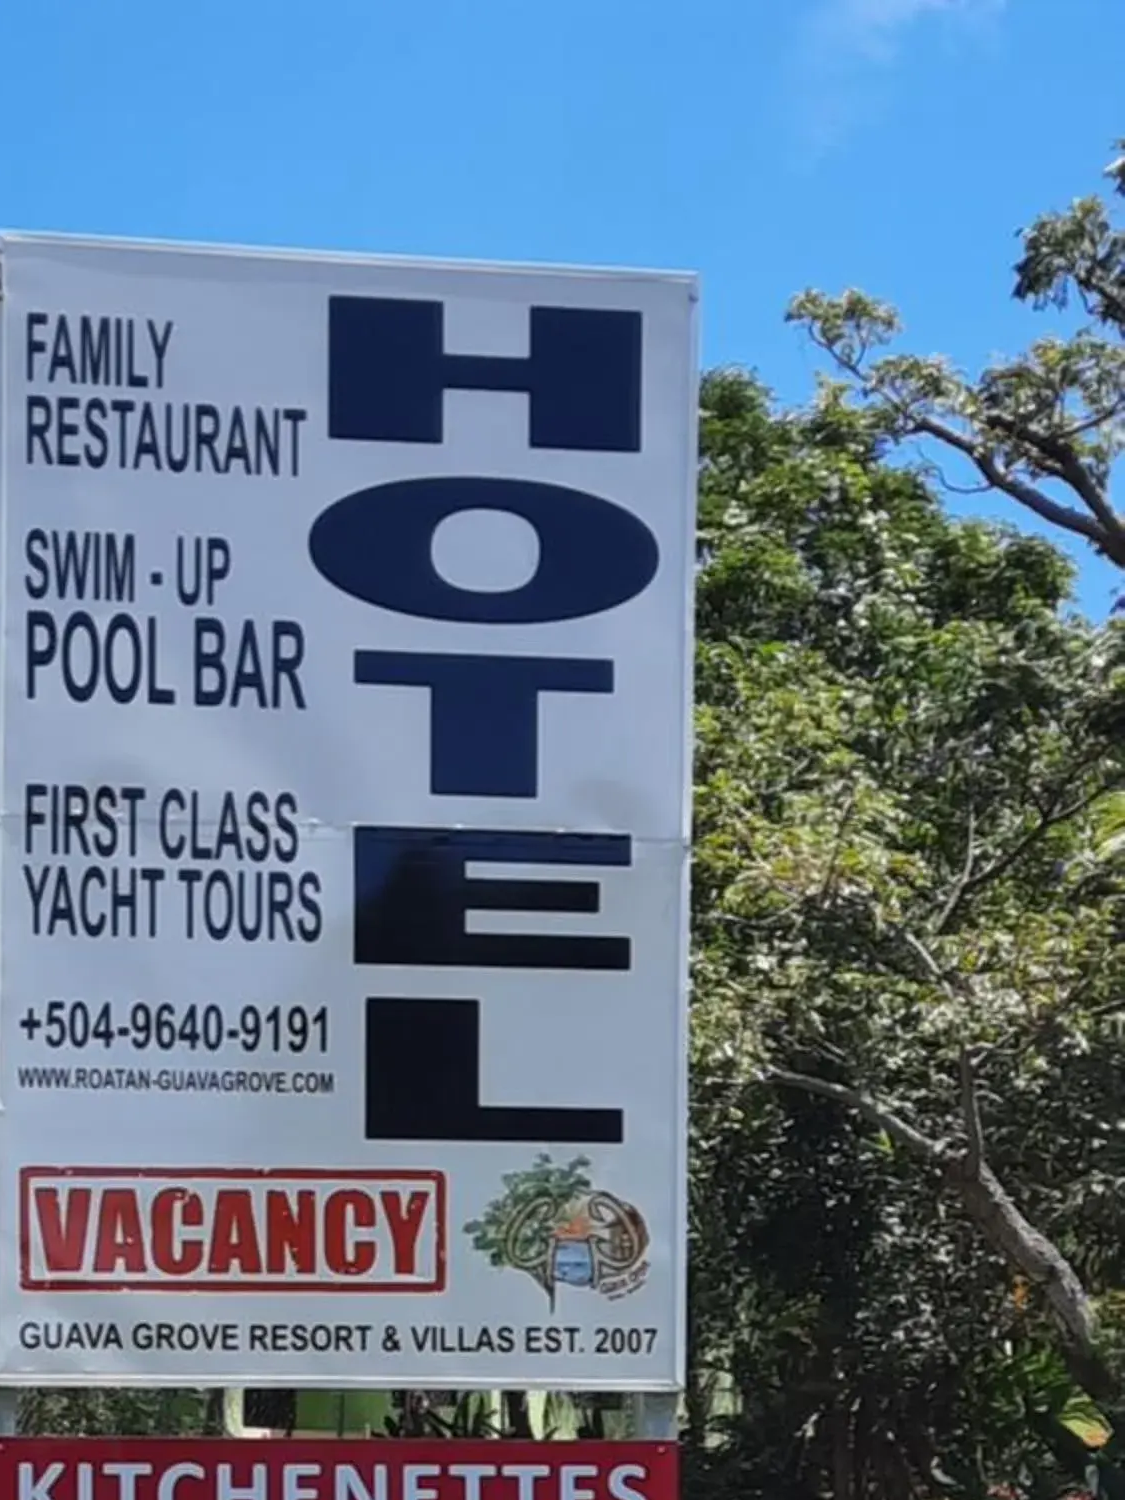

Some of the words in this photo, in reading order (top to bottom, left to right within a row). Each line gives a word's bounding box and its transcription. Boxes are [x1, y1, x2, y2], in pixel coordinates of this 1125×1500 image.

[26, 312, 174, 389] FAMILY
[26, 396, 307, 477] RESTAURANT
[24, 528, 135, 603] SWIM
[176, 536, 231, 606] UP
[26, 611, 175, 705] POOL
[193, 617, 307, 710] BAR
[308, 294, 659, 1144] HOTEL
[24, 783, 146, 858] FIRST
[158, 789, 299, 863] CLASS
[23, 864, 166, 938] YACHT
[180, 869, 322, 943] TOURS
[19, 1001, 329, 1053] +504-9640-9191
[18, 1068, 334, 1094] WWW.ROATAN-GUAVAGROVE.COM
[35, 1188, 430, 1275] VACANCY
[20, 1323, 123, 1350] GUAVA
[131, 1323, 239, 1351] GROVE
[249, 1325, 372, 1352] RESORT
[381, 1326, 401, 1353] &
[411, 1327, 515, 1353] VILLAS
[525, 1327, 585, 1354] EST.
[594, 1328, 658, 1354] 2007
